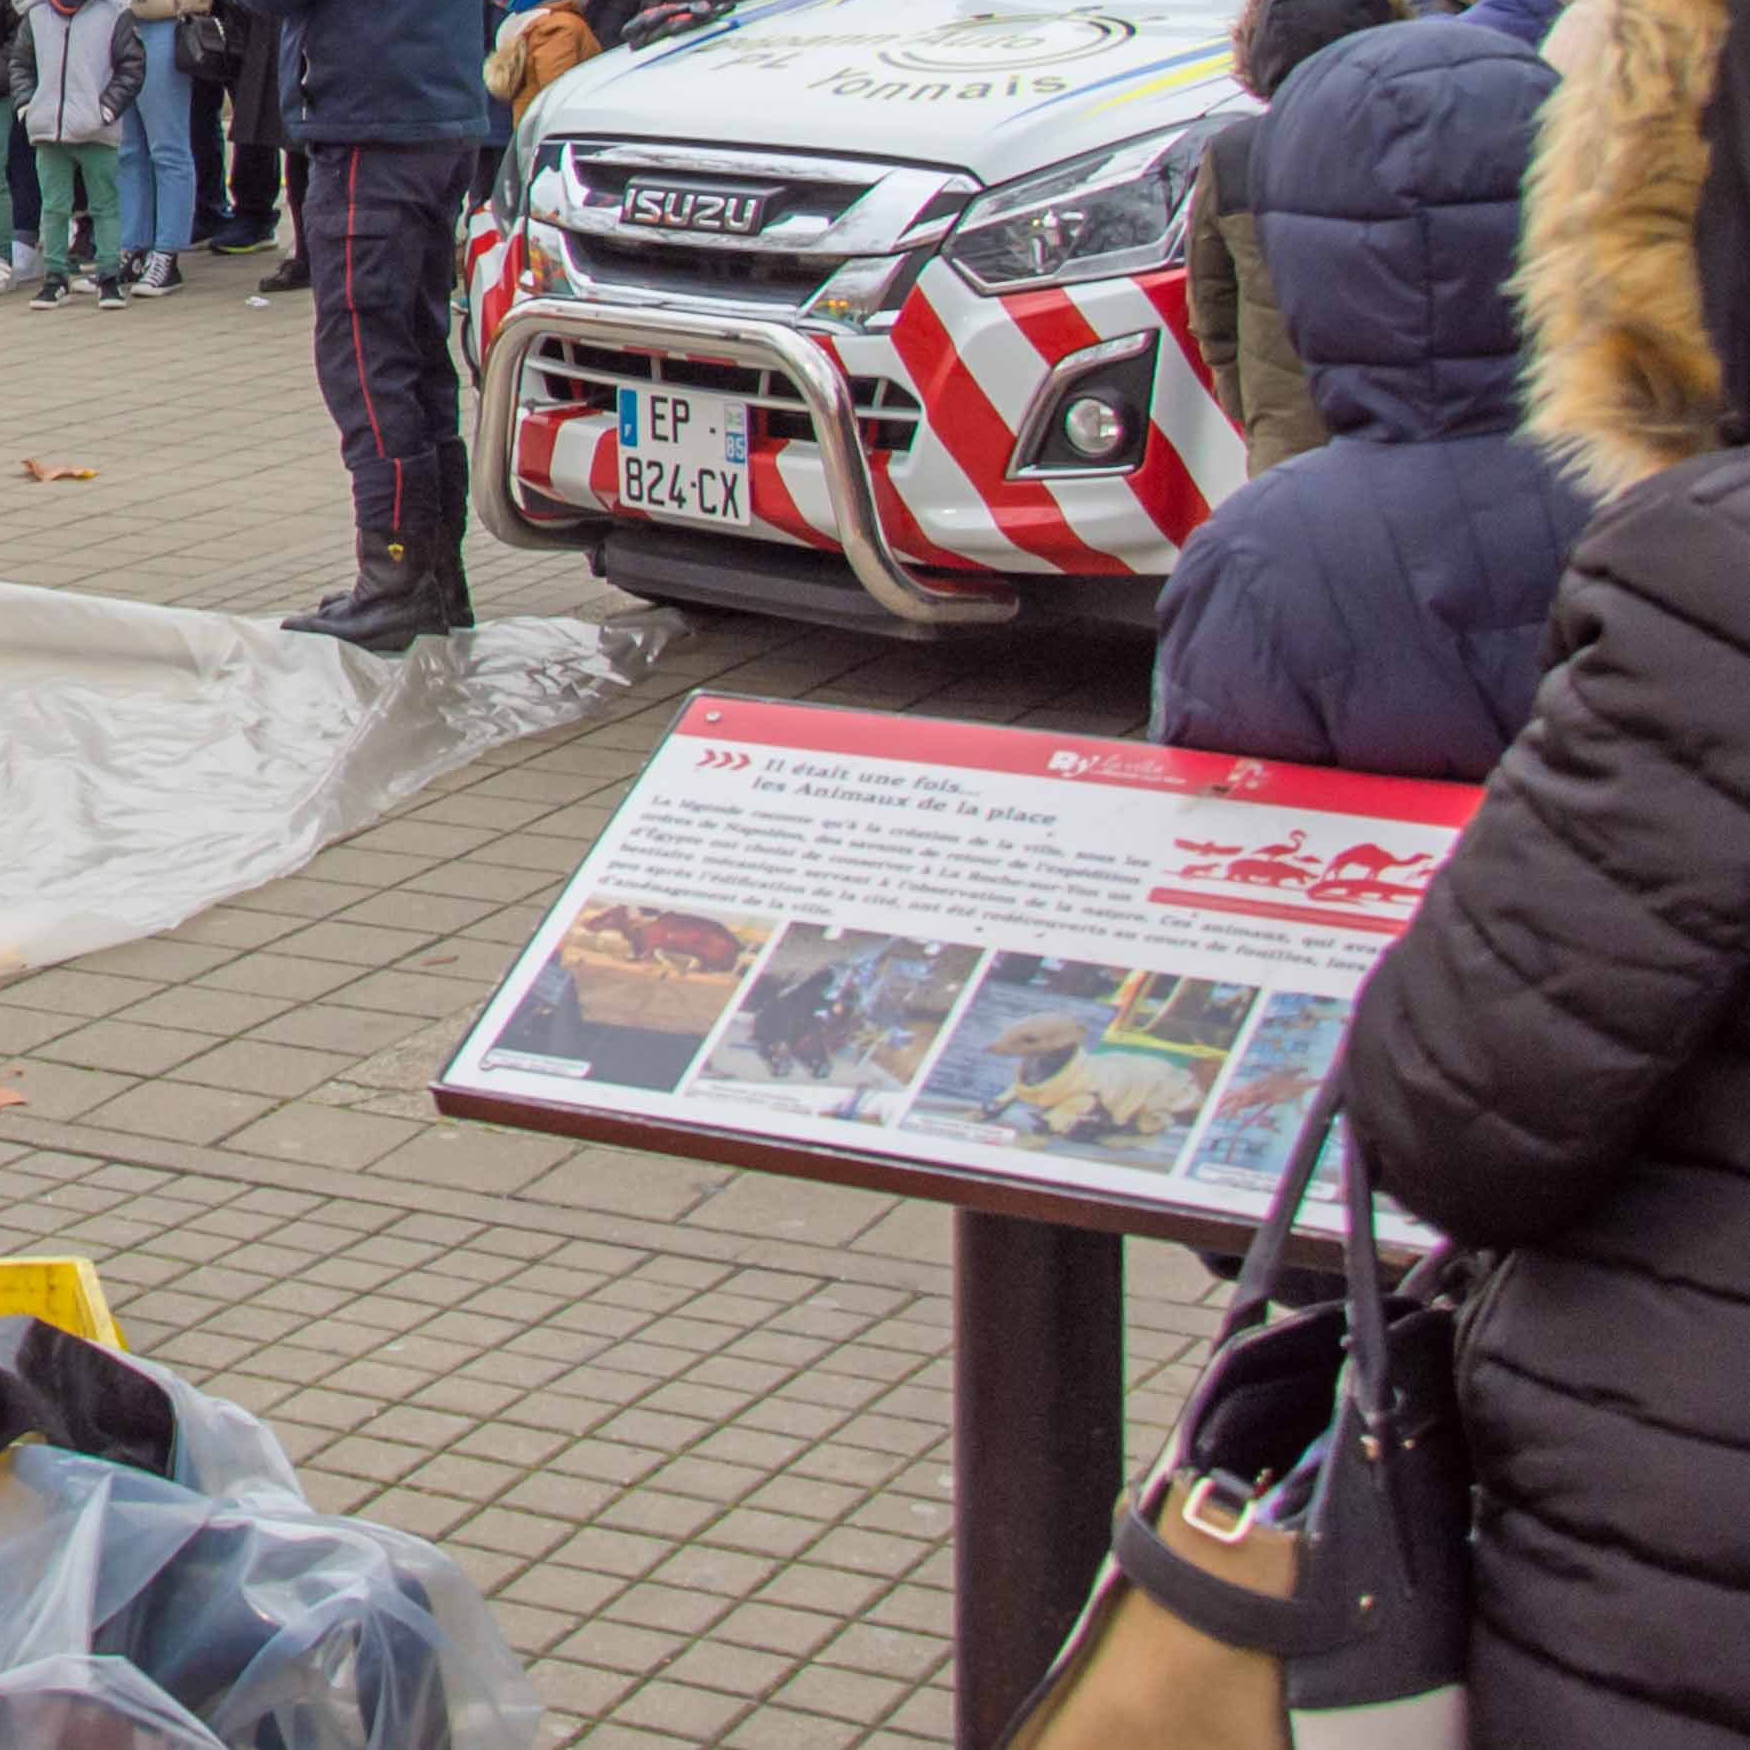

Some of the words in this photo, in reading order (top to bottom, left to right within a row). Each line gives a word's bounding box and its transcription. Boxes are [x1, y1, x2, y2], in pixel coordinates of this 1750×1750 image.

[806, 66, 1070, 102] Yonnais
[623, 187, 758, 233] ISUZU
[763, 758, 786, 773] Il
[791, 760, 850, 783] était
[858, 770, 906, 788] une
[751, 776, 787, 793] les
[795, 780, 908, 809] Animaux
[917, 797, 948, 814] de
[955, 801, 980, 817] la
[984, 804, 1058, 827] place
